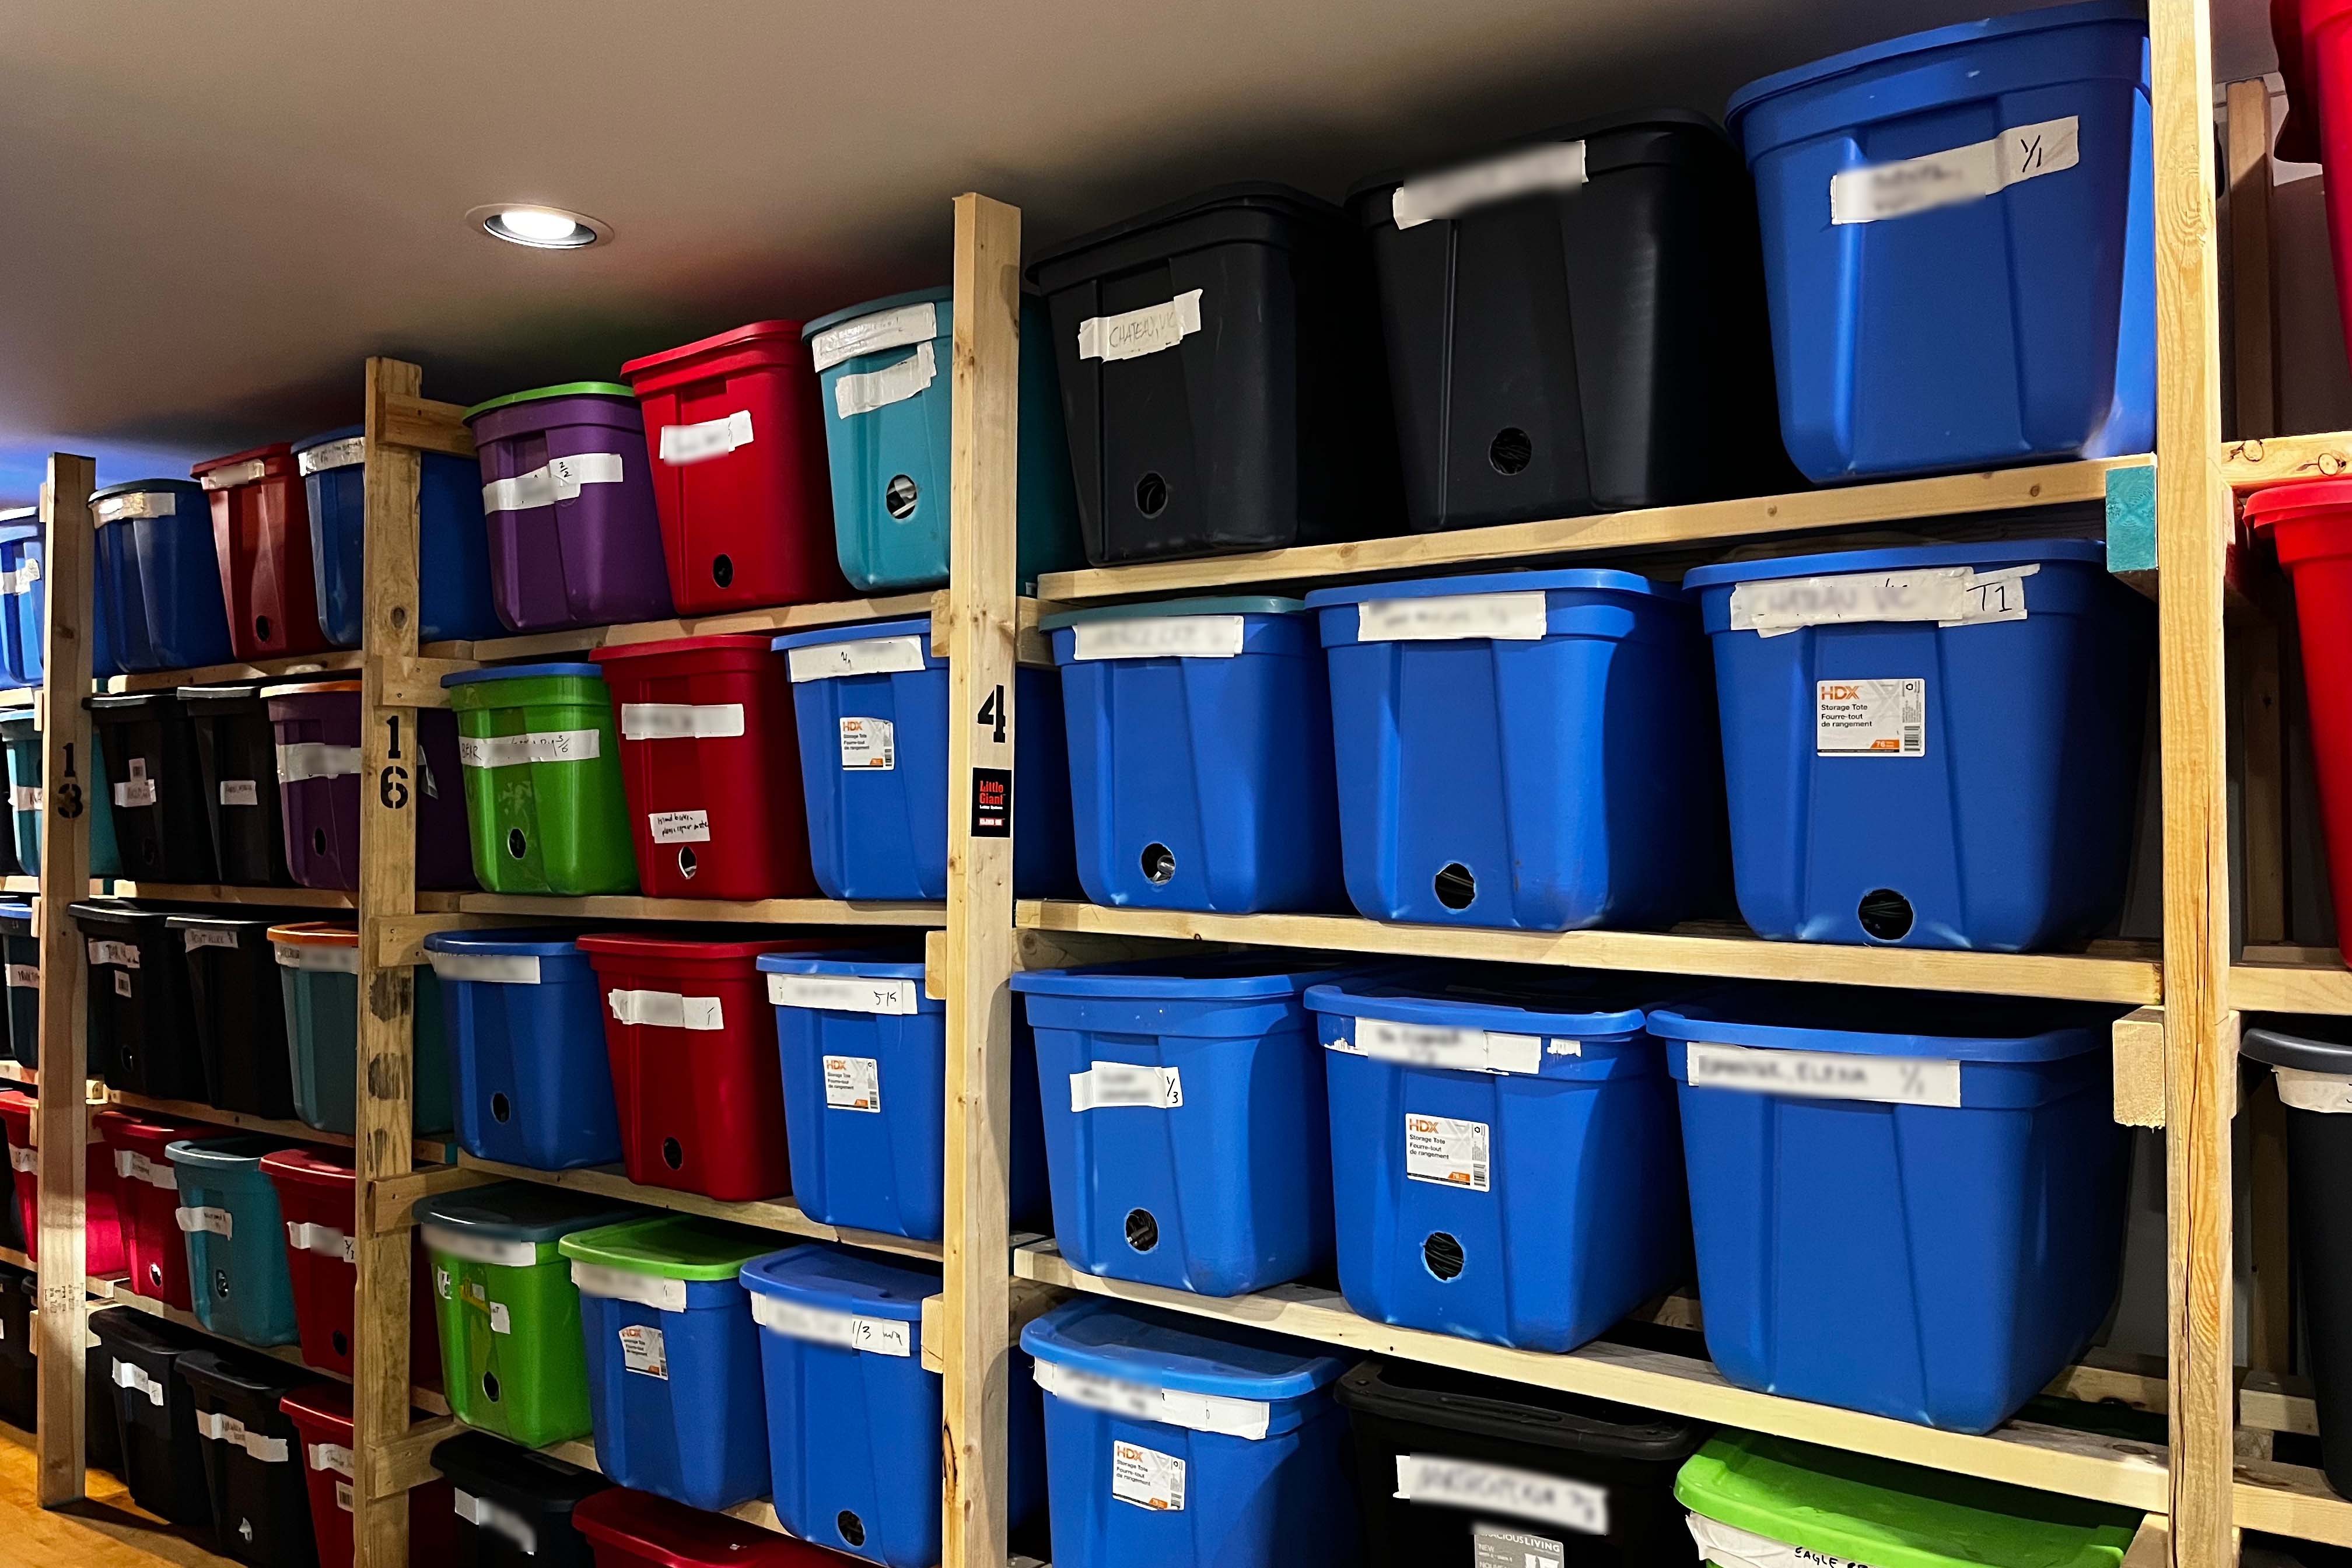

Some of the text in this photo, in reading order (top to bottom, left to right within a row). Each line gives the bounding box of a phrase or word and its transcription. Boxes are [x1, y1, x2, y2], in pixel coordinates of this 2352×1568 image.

[1821, 685, 1860, 700] HDX
[977, 684, 1006, 743] 4
[979, 780, 1004, 793] Little
[979, 792, 1004, 805] Giant
[1167, 1076, 1178, 1104] 1/3
[1409, 1118, 1439, 1134] HDX
[1409, 1134, 1432, 1143] Storage
[1418, 1150, 1449, 1160] rangement
[1116, 1446, 1143, 1462] HDX
[1524, 1537, 1560, 1552] LIVING
